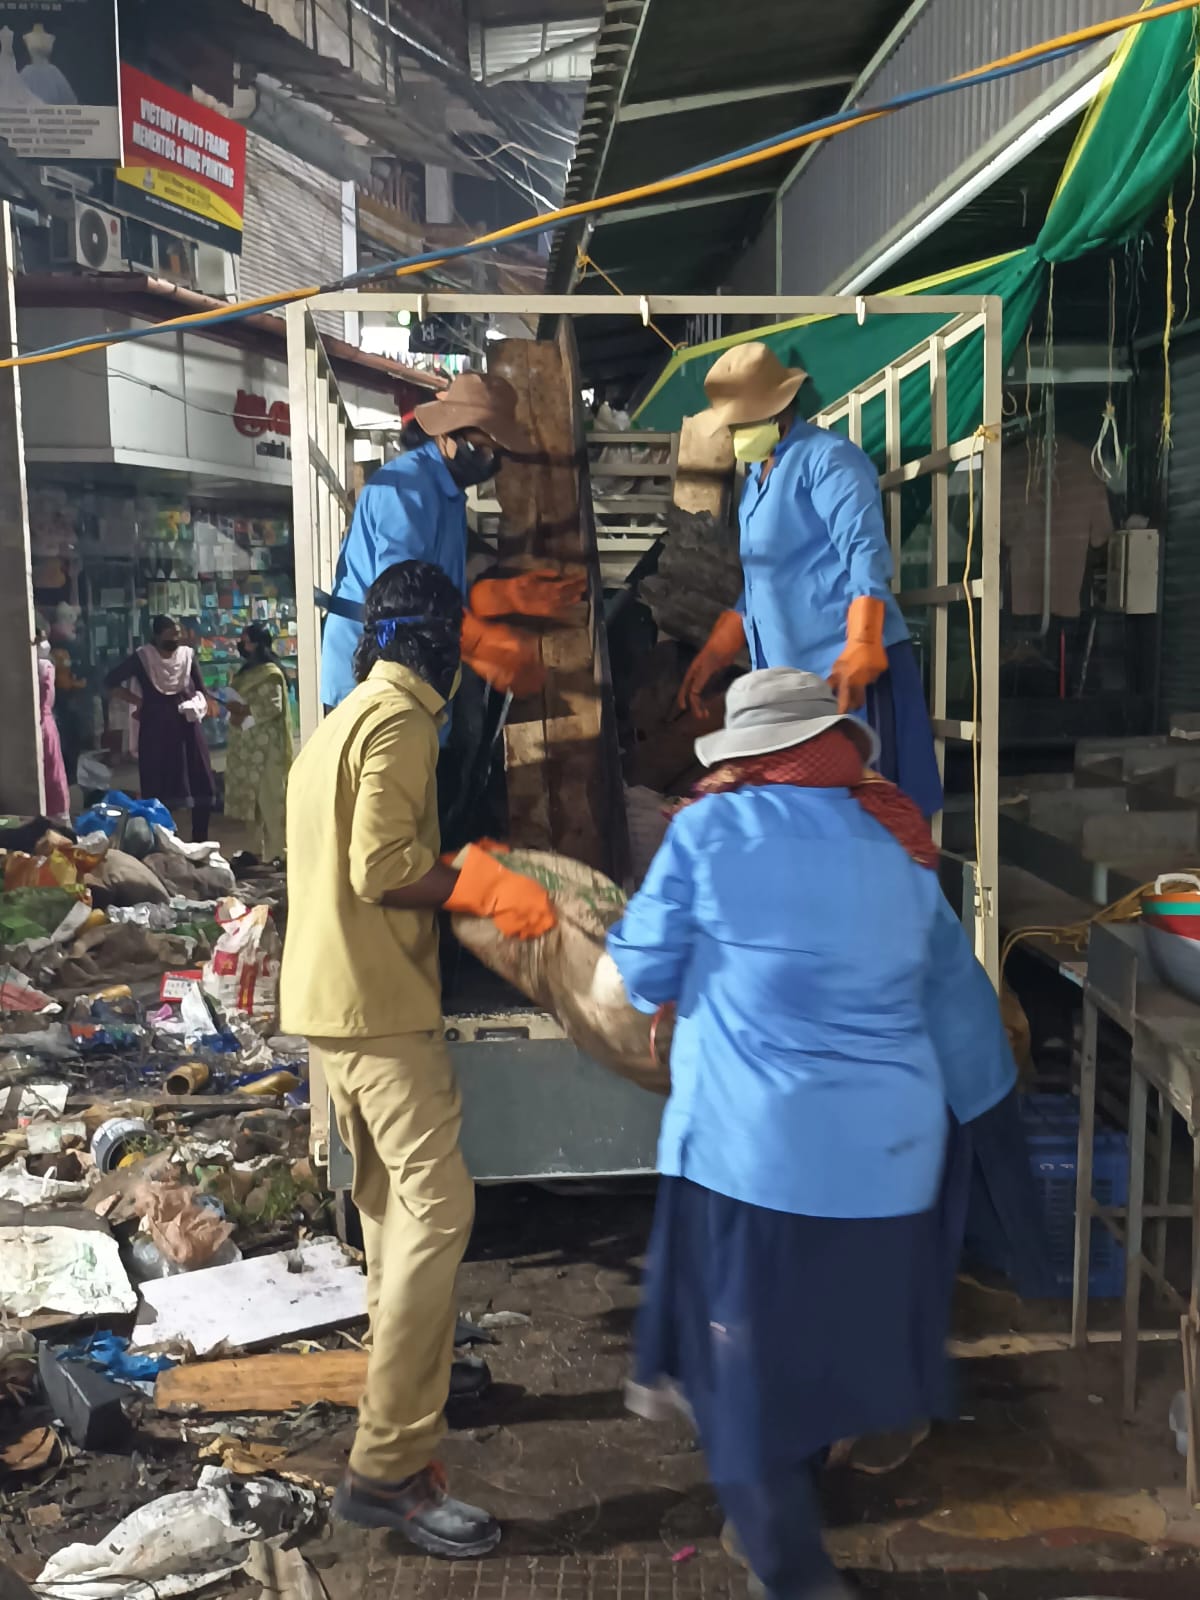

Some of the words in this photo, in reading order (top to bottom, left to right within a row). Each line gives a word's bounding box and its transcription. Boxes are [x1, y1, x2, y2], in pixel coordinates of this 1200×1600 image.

[132, 120, 176, 161] MEMENTOS
[176, 145, 184, 165] &
[201, 154, 234, 189] PRINTING
[140, 97, 177, 134] VICTORY
[178, 116, 204, 148] PHOTO
[204, 130, 229, 161] FRAME
